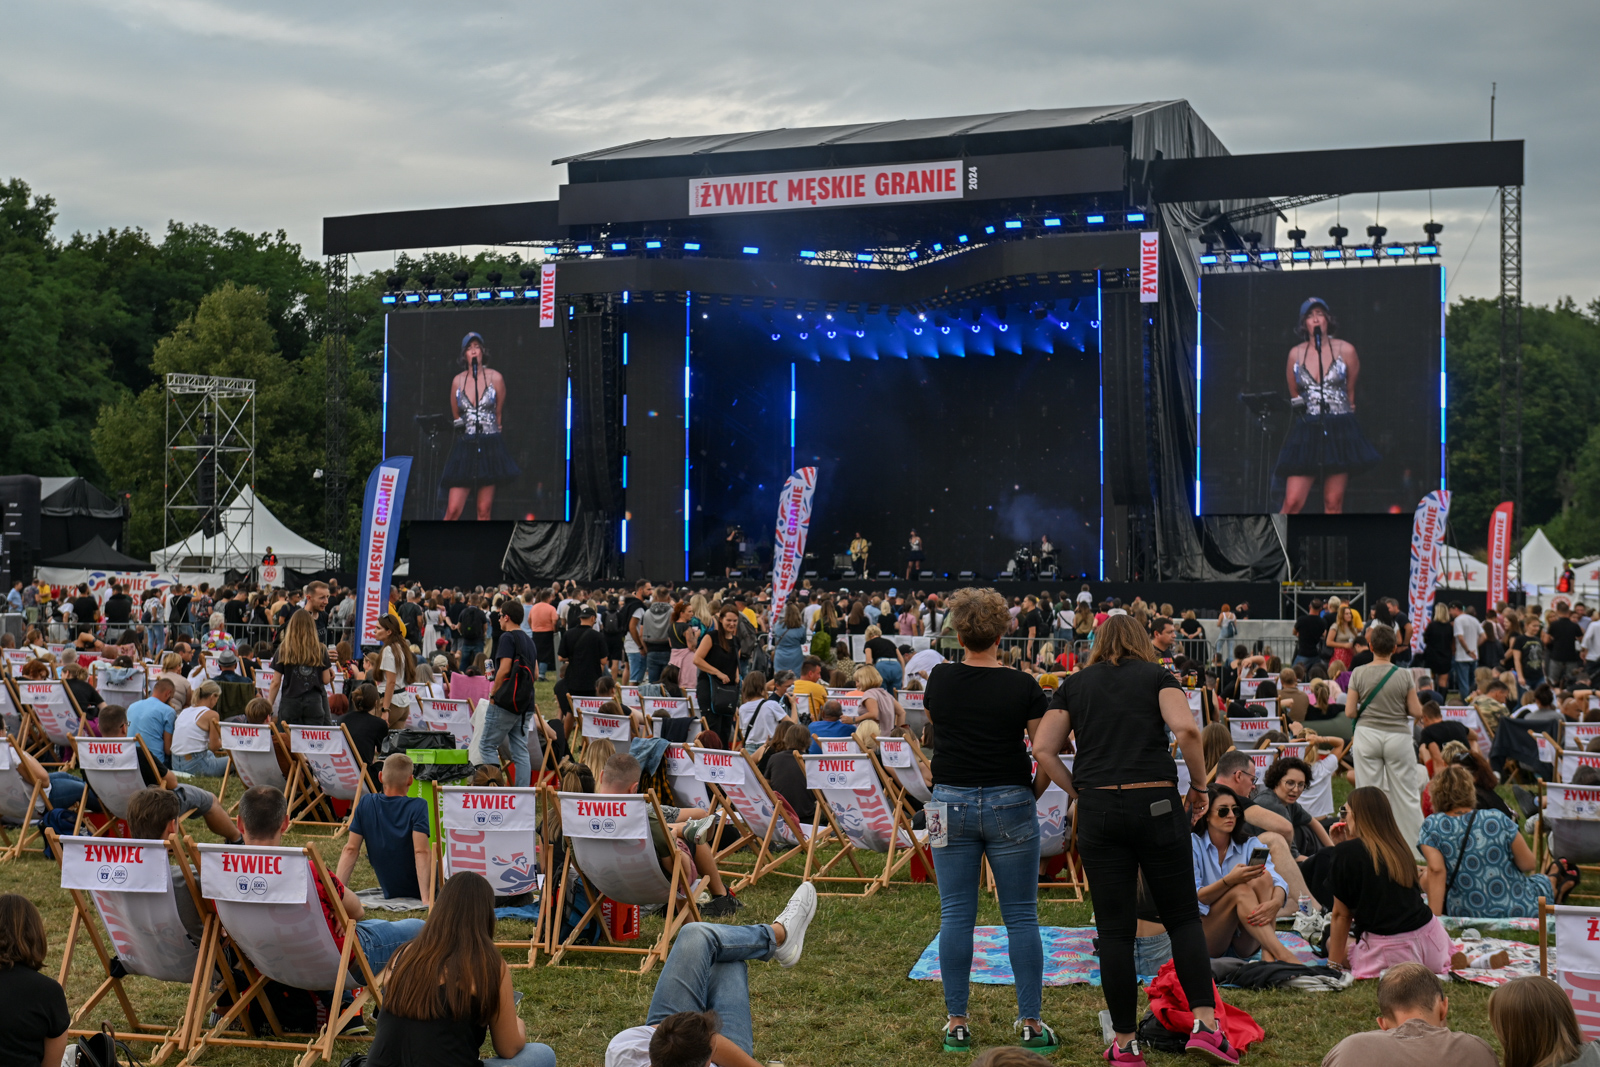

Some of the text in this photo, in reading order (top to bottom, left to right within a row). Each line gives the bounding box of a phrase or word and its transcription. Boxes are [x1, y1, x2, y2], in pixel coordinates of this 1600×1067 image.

[969, 166, 978, 190] 2024
[700, 180, 778, 208] ŻYWIEC
[788, 174, 866, 206] MĘSKIE
[875, 168, 957, 197] GRANIE
[1140, 239, 1158, 294] ŻYWIEC
[540, 270, 555, 320] ŻYWIEC
[375, 473, 395, 527] GRANIE
[787, 485, 803, 536] GRANIE
[1422, 505, 1438, 552] GRANIE
[1495, 517, 1505, 559] GRANIE
[369, 530, 386, 583] MĘSKIE
[1417, 554, 1430, 601] MĘSKIE
[363, 587, 381, 640] ŻYWIEC
[27, 684, 52, 693] ŻYWIEC
[432, 701, 458, 712] ŻYWIEC
[653, 699, 678, 709] ŻYWIEC
[230, 726, 259, 737] ŻYWIEC
[592, 717, 620, 728] ŻYWIEC
[1240, 720, 1269, 730] ŻYWIEC
[301, 730, 331, 741] ŻYWIEC
[88, 743, 123, 754] ŻYWIEC
[827, 741, 848, 752] ŻYWIEC
[884, 741, 902, 752] ŻYWIEC
[703, 753, 732, 767] ŻYWIEC
[818, 759, 855, 772] ŻYWIEC
[462, 792, 516, 810] ŻYWIEC
[577, 800, 627, 817] ŻYWIEC
[84, 844, 144, 864] ŻYWIEC
[221, 851, 283, 875] ŻYWIEC
